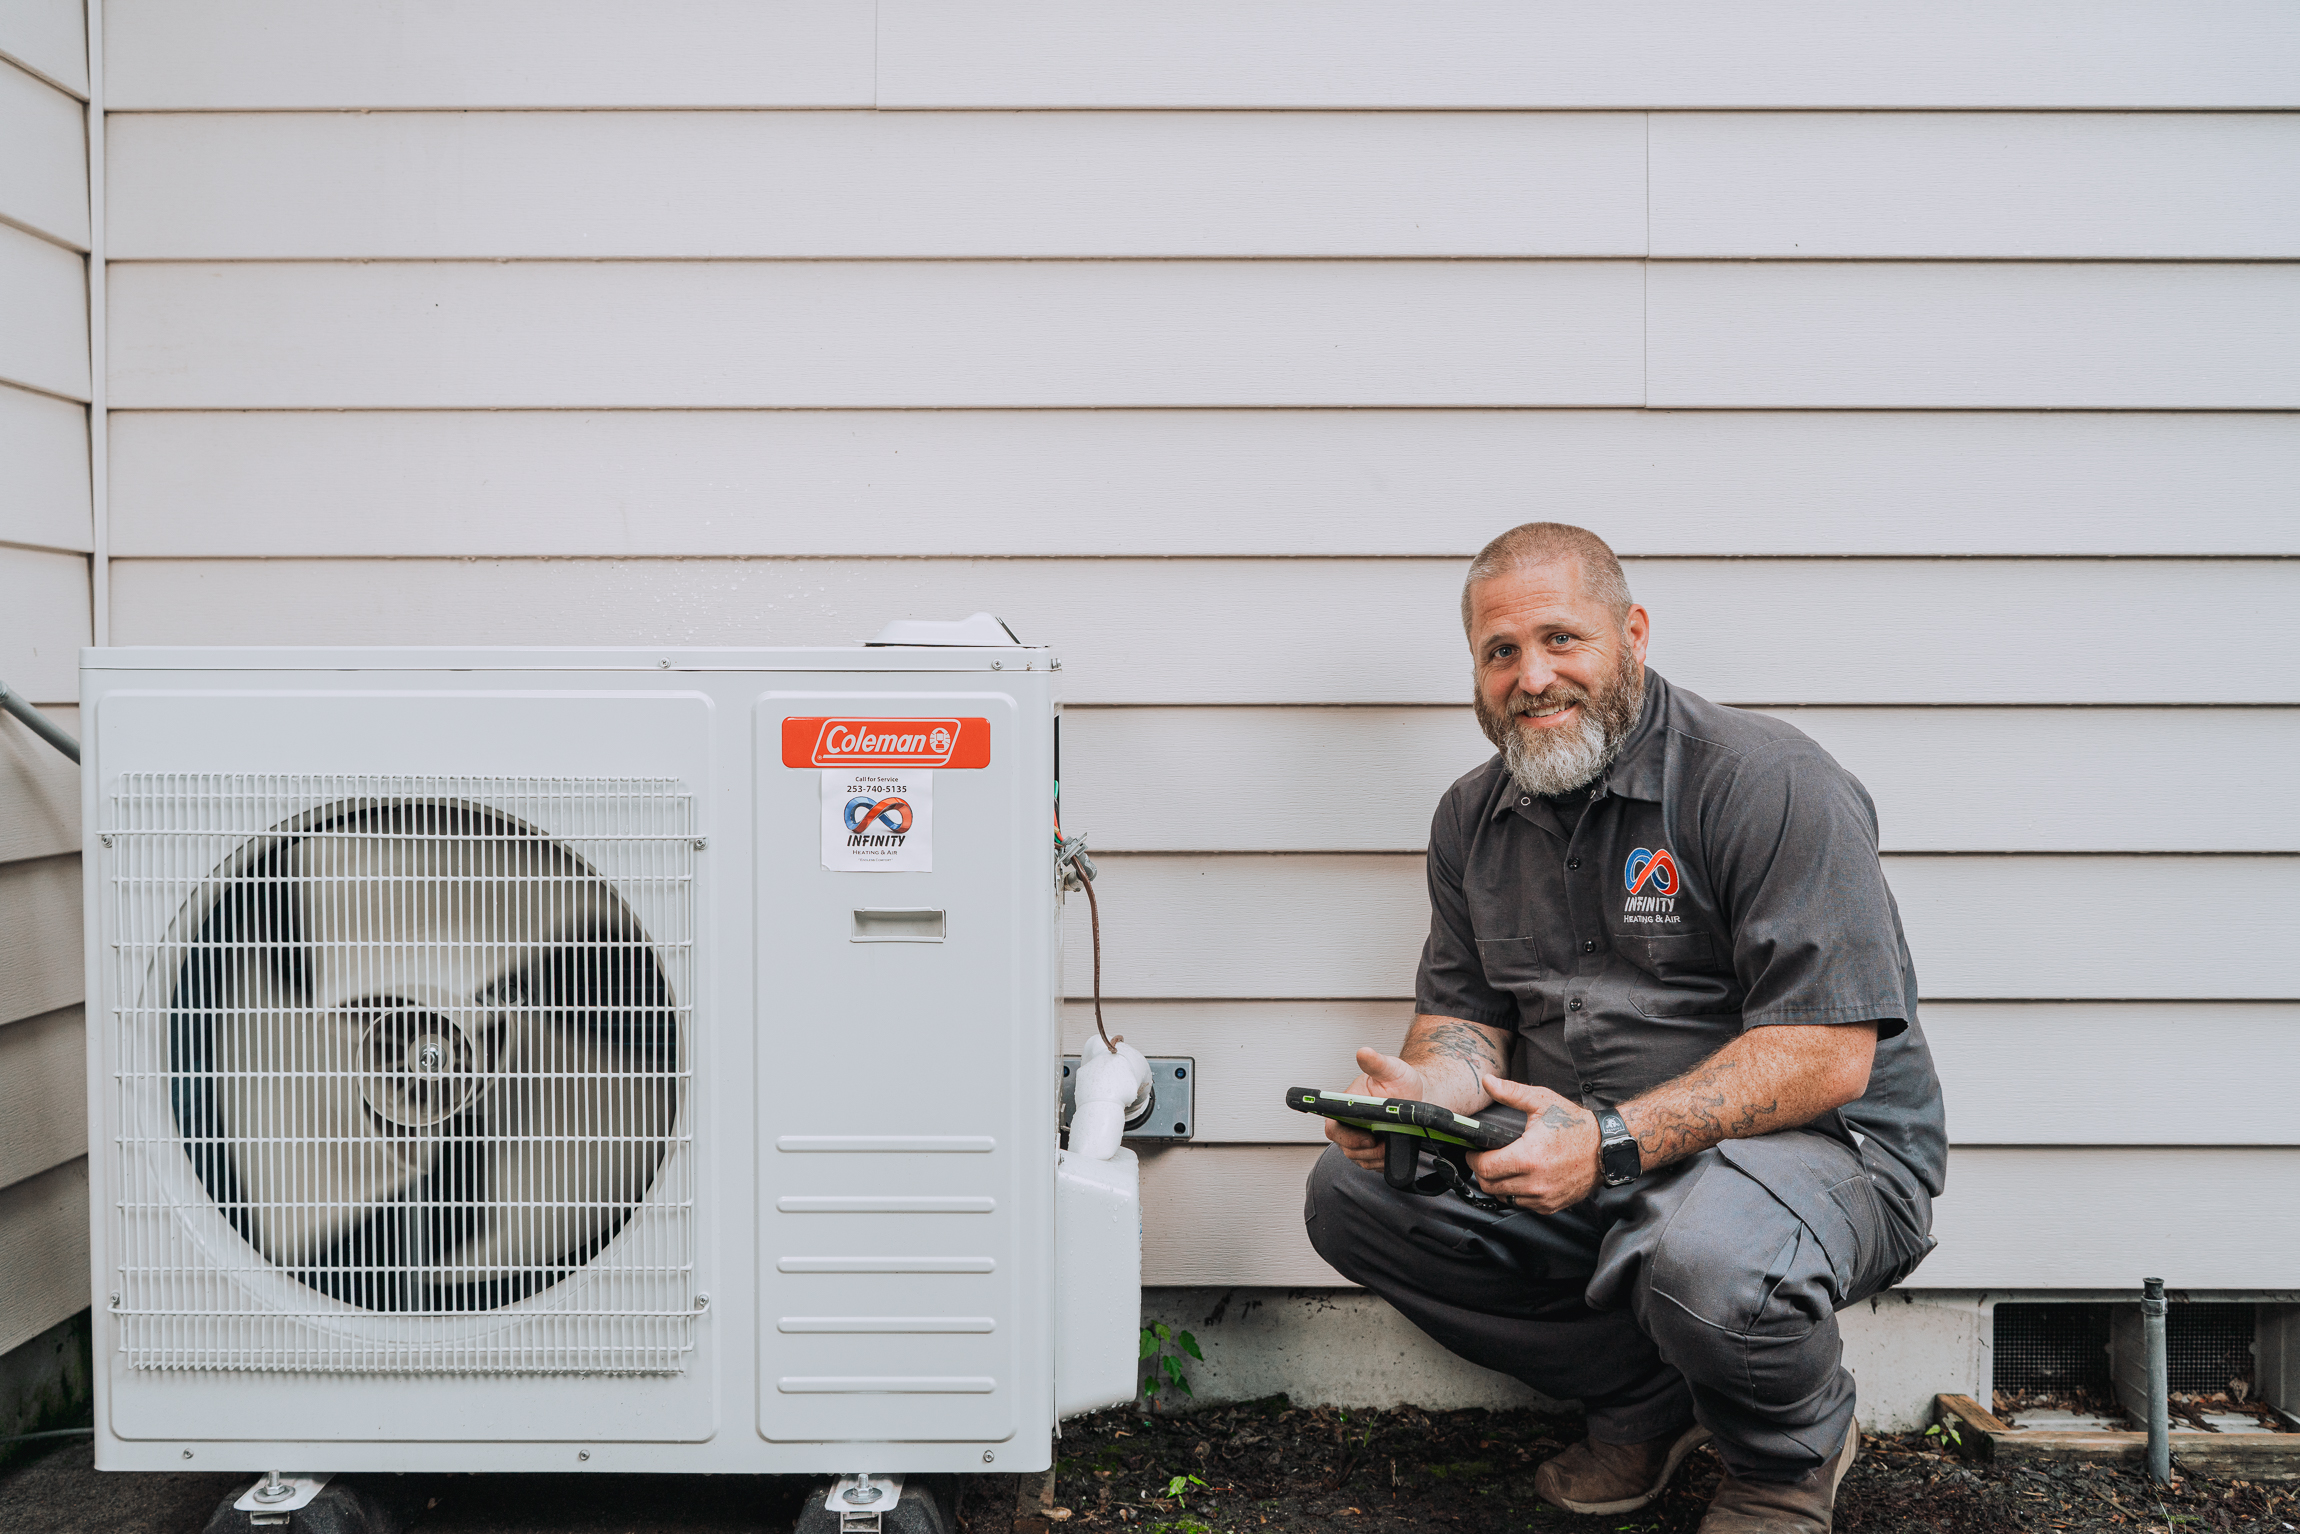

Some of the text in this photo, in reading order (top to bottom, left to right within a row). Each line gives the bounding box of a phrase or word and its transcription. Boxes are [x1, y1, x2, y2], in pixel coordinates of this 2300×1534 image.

[826, 725, 927, 754] Coleman
[846, 785, 907, 793] 253-740-5135
[847, 834, 906, 847] INFINITY
[1624, 896, 1675, 912] INFINITY
[1655, 914, 1664, 923] &
